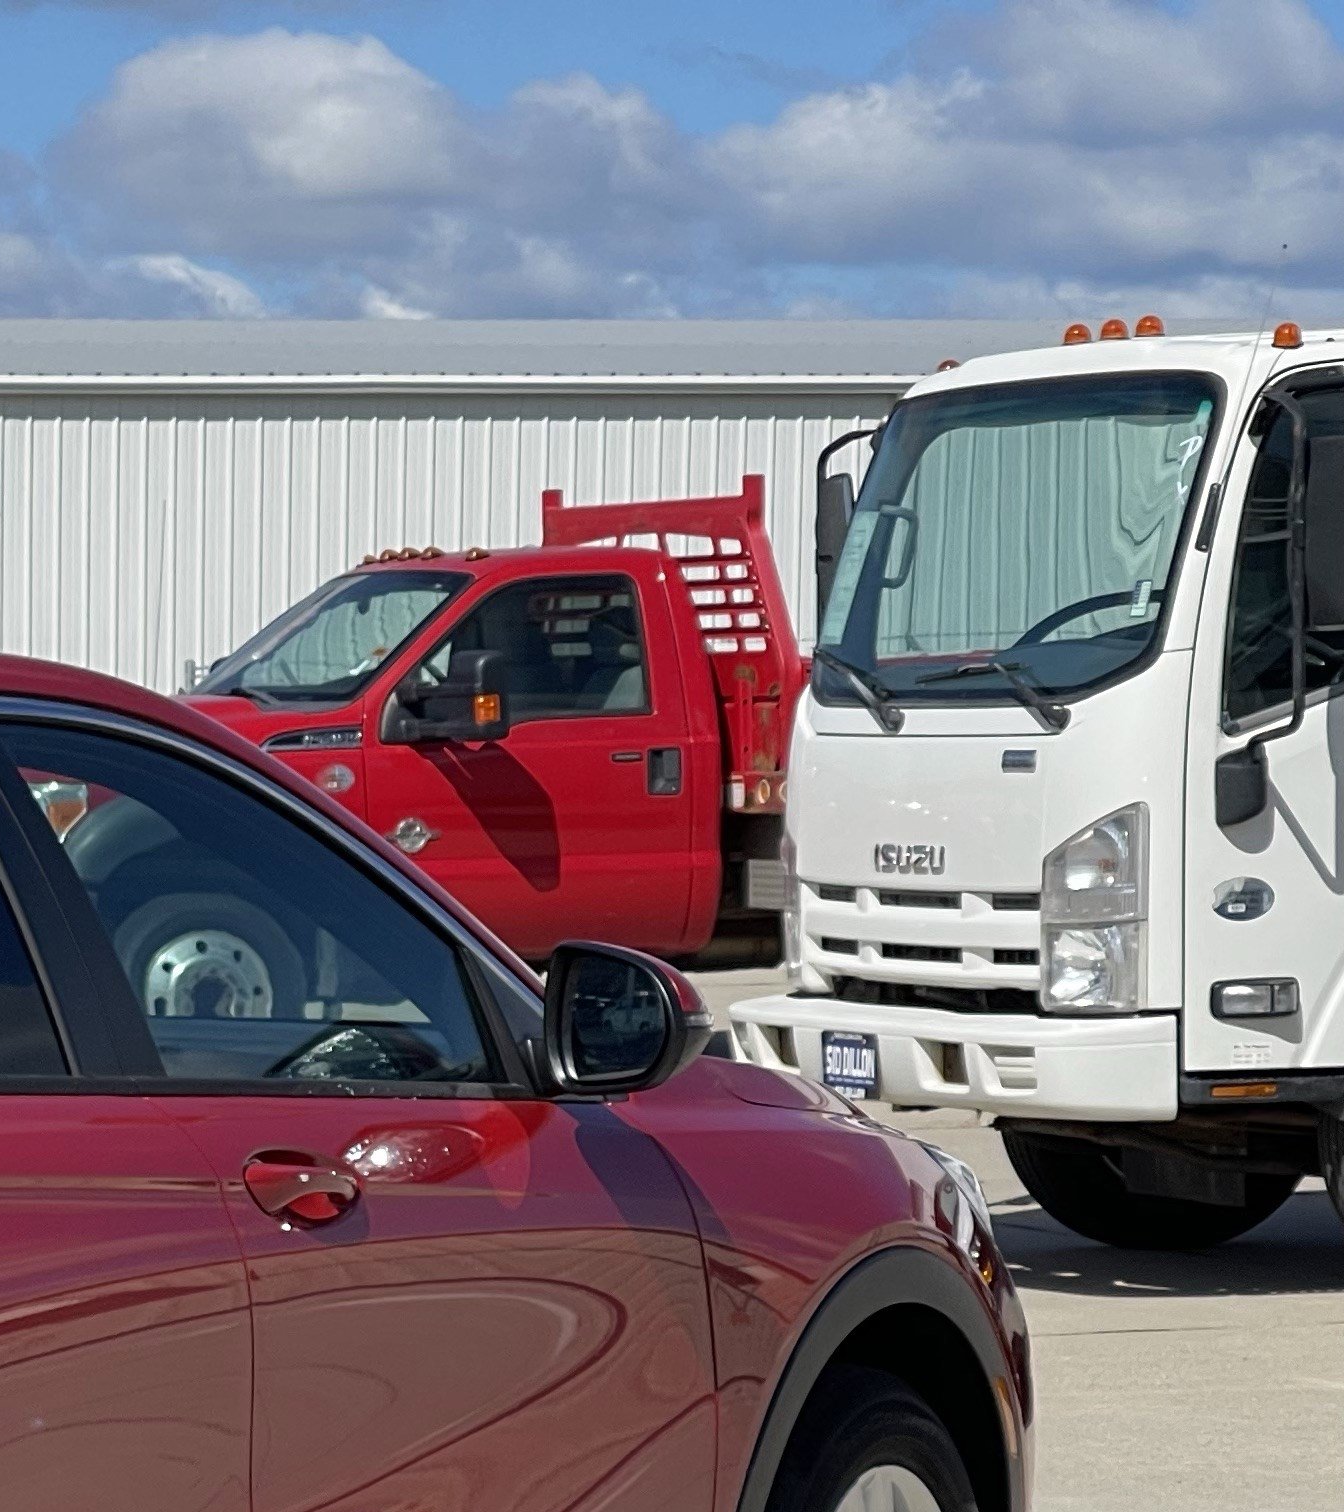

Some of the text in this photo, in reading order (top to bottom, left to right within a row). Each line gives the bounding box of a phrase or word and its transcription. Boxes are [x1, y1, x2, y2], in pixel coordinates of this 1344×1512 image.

[874, 843, 946, 876] ISUZU
[825, 1045, 875, 1079] SID DILLON
